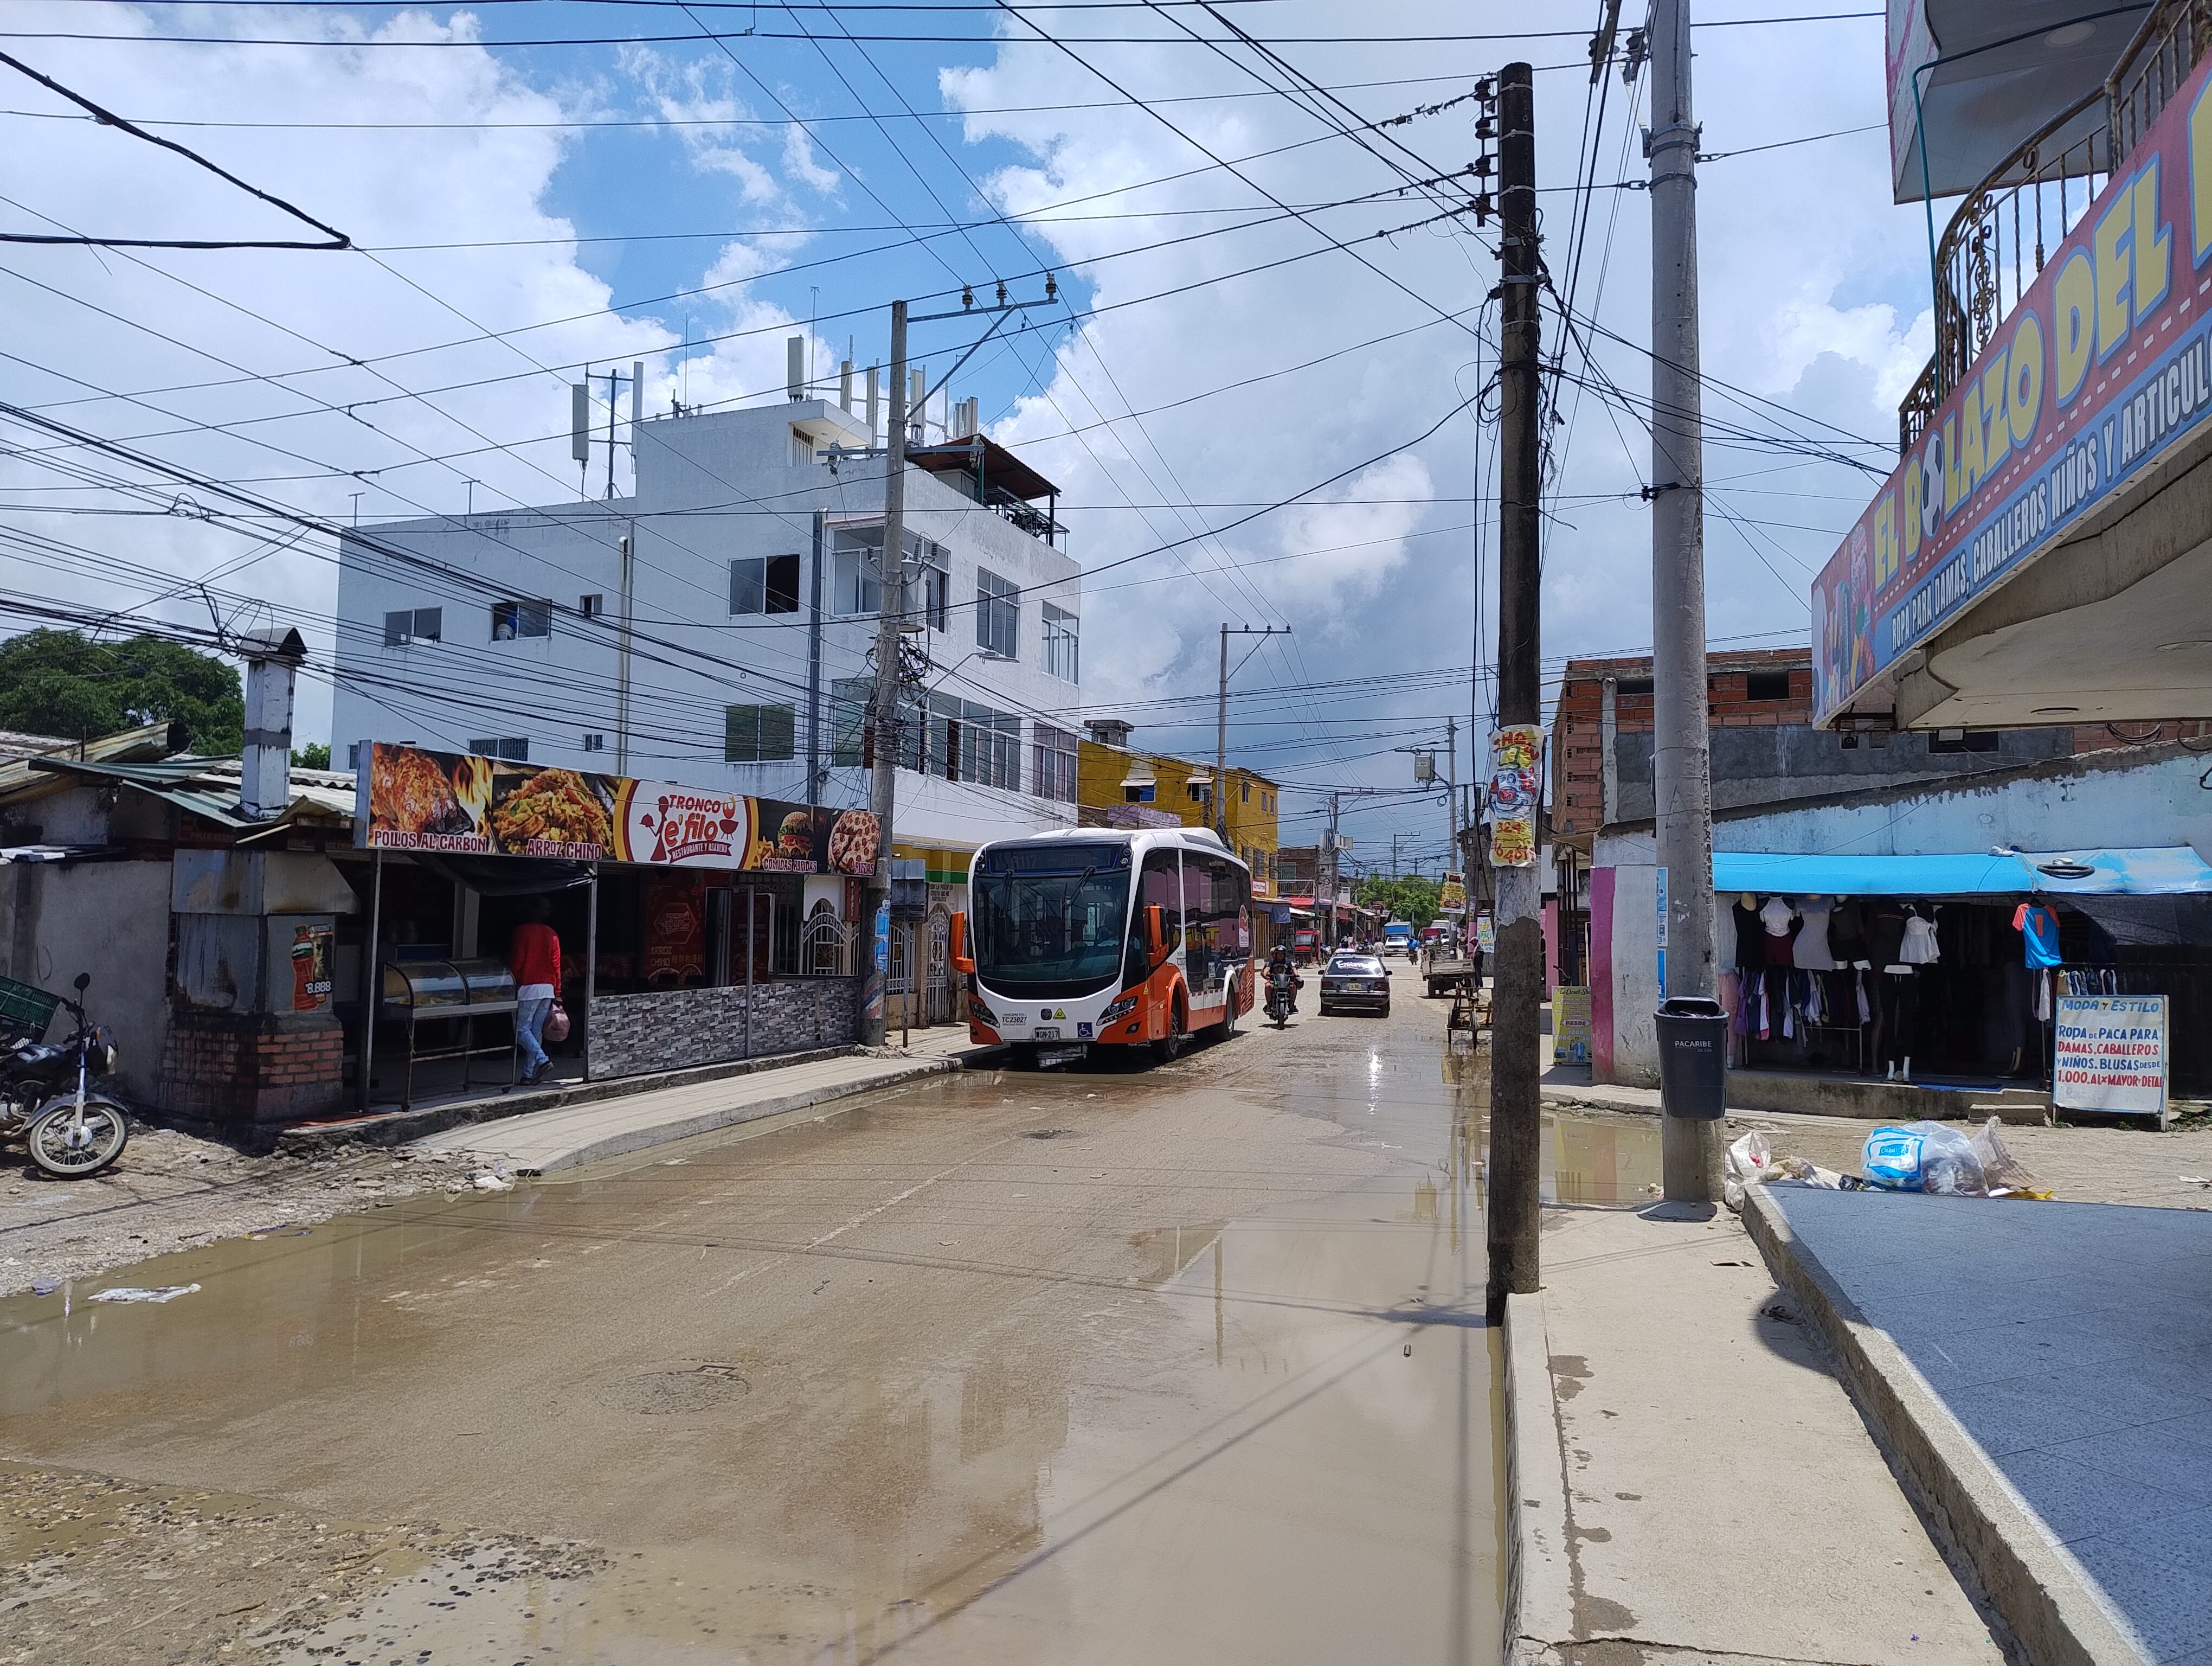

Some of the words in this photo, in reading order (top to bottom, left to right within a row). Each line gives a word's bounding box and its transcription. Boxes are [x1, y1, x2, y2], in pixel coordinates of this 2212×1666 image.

[1874, 491, 1899, 591] EL
[2055, 162, 2169, 401] DEL
[1892, 605, 1909, 651] ROPA
[1912, 584, 1932, 635] PARA
[1935, 553, 1970, 617] DAMAS,
[1973, 483, 2046, 584] CABALLEROS
[2052, 438, 2097, 522] NIÑOS
[2104, 420, 2114, 477] Y
[668, 794, 721, 813] TRONCO
[374, 830, 417, 848] POLLOS
[421, 834, 435, 849] AL
[440, 835, 486, 852] CARBON
[527, 840, 563, 857] ARROZ
[566, 842, 601, 860] CHINO
[672, 843, 704, 860] RESTAURANTE
[704, 843, 708, 852] Y
[764, 858, 792, 870] COMIDAS
[793, 860, 817, 872] RAPIDAS
[854, 862, 874, 874] PIZZAS
[651, 946, 673, 955] ARROZ
[651, 958, 670, 967] CHINO
[2061, 1000, 2099, 1010] MODA
[2111, 999, 2159, 1013] ESTILO
[2059, 1025, 2087, 1040] ROPA
[2099, 1028, 2127, 1040] PACA
[2130, 1028, 2158, 1040] PARA
[2097, 1043, 2159, 1055] CABALLEROS
[2062, 1055, 2098, 1069] NIÑOS.
[2100, 1058, 2139, 1071] BLUSAS
[2139, 1061, 2160, 1069] DESDE
[2107, 1074, 2138, 1087] MAYOR
